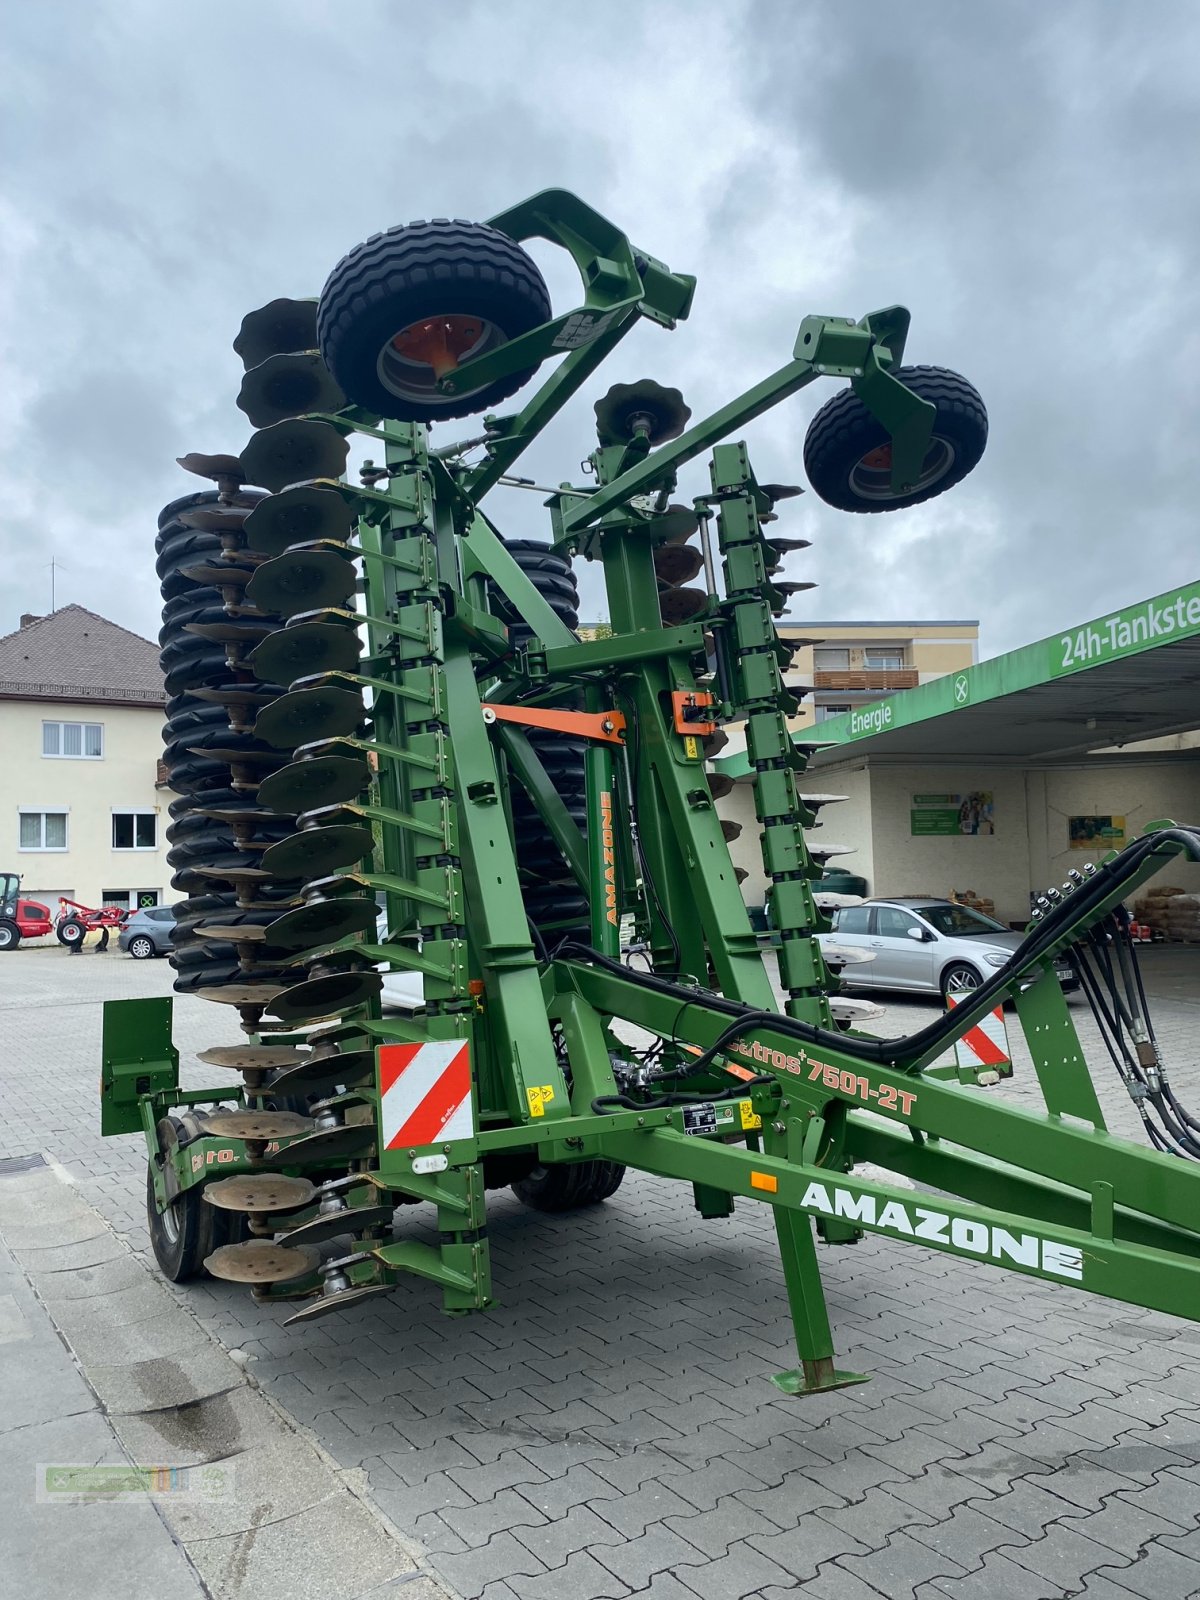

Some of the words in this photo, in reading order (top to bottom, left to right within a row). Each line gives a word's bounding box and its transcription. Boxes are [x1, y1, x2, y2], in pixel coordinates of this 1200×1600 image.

[851, 702, 892, 734] Energie
[600, 791, 617, 927] AMAZONE
[807, 1059, 917, 1116] 7501-2T
[800, 1182, 1083, 1281] AMAZONE
